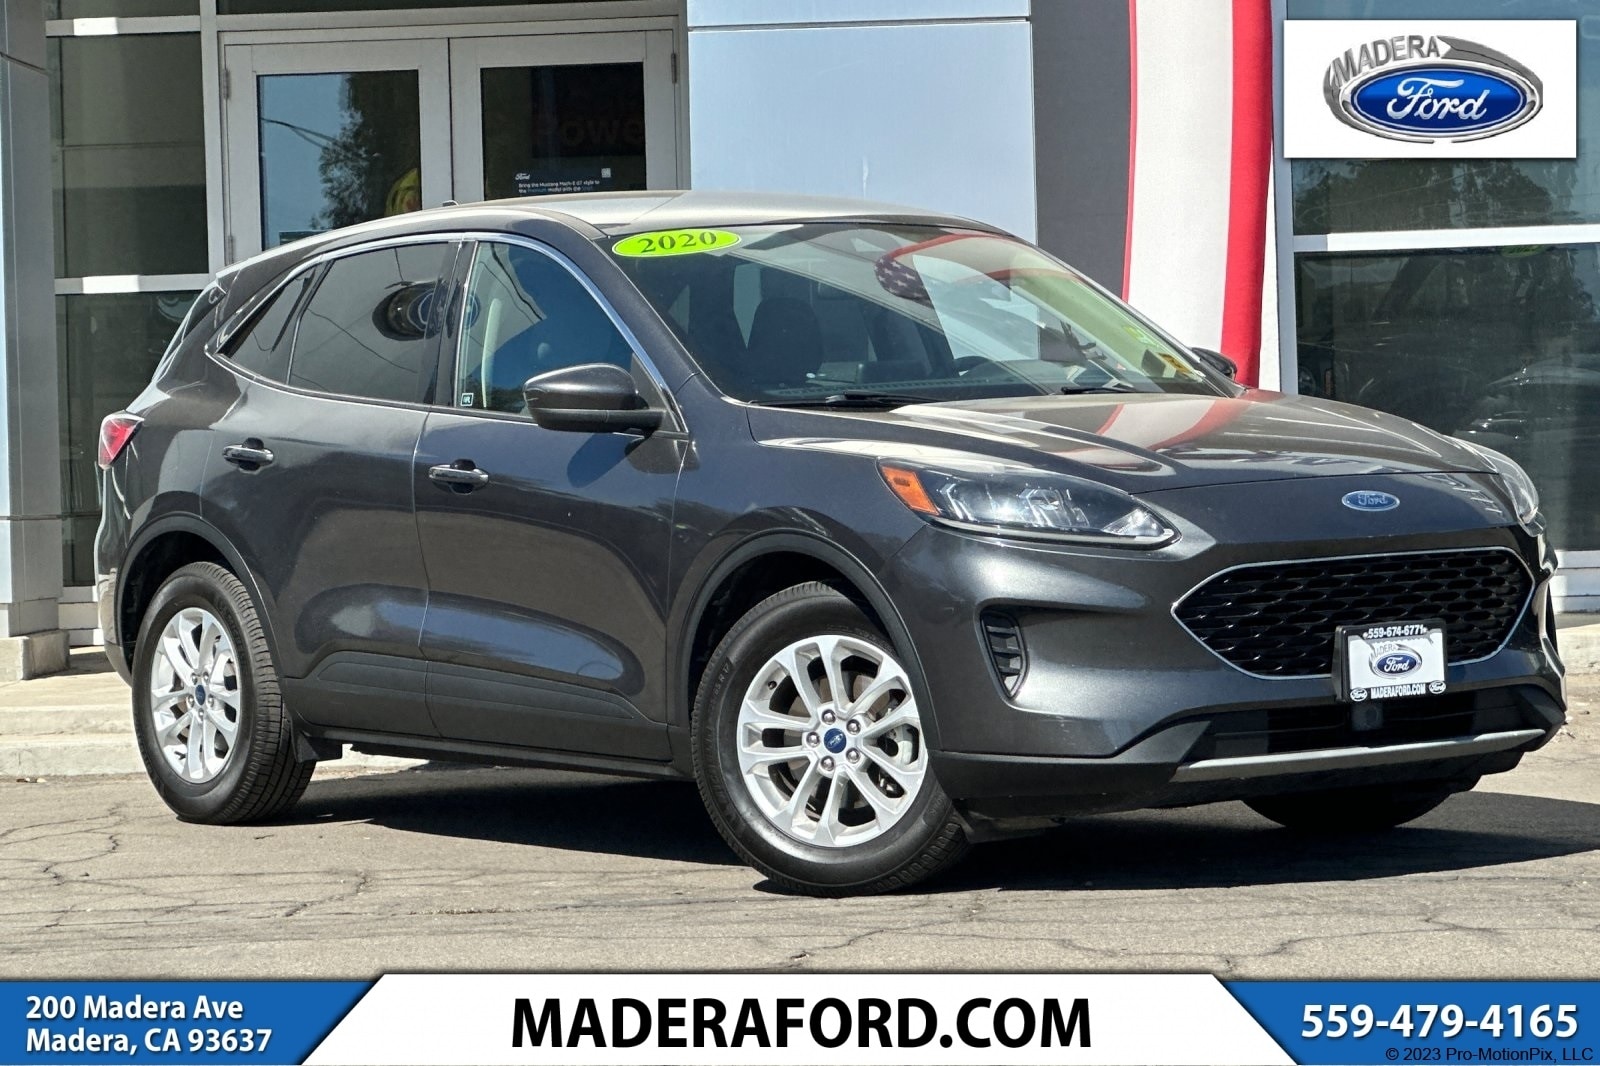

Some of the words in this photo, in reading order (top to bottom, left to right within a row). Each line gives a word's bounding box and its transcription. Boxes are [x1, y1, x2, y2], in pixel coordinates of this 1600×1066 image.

[514, 172, 531, 181] Ford
[638, 231, 717, 254] 2020
[1357, 493, 1388, 506] Ford
[1383, 657, 1410, 672] Ford
[1370, 683, 1427, 699] MADERAFORD.COM
